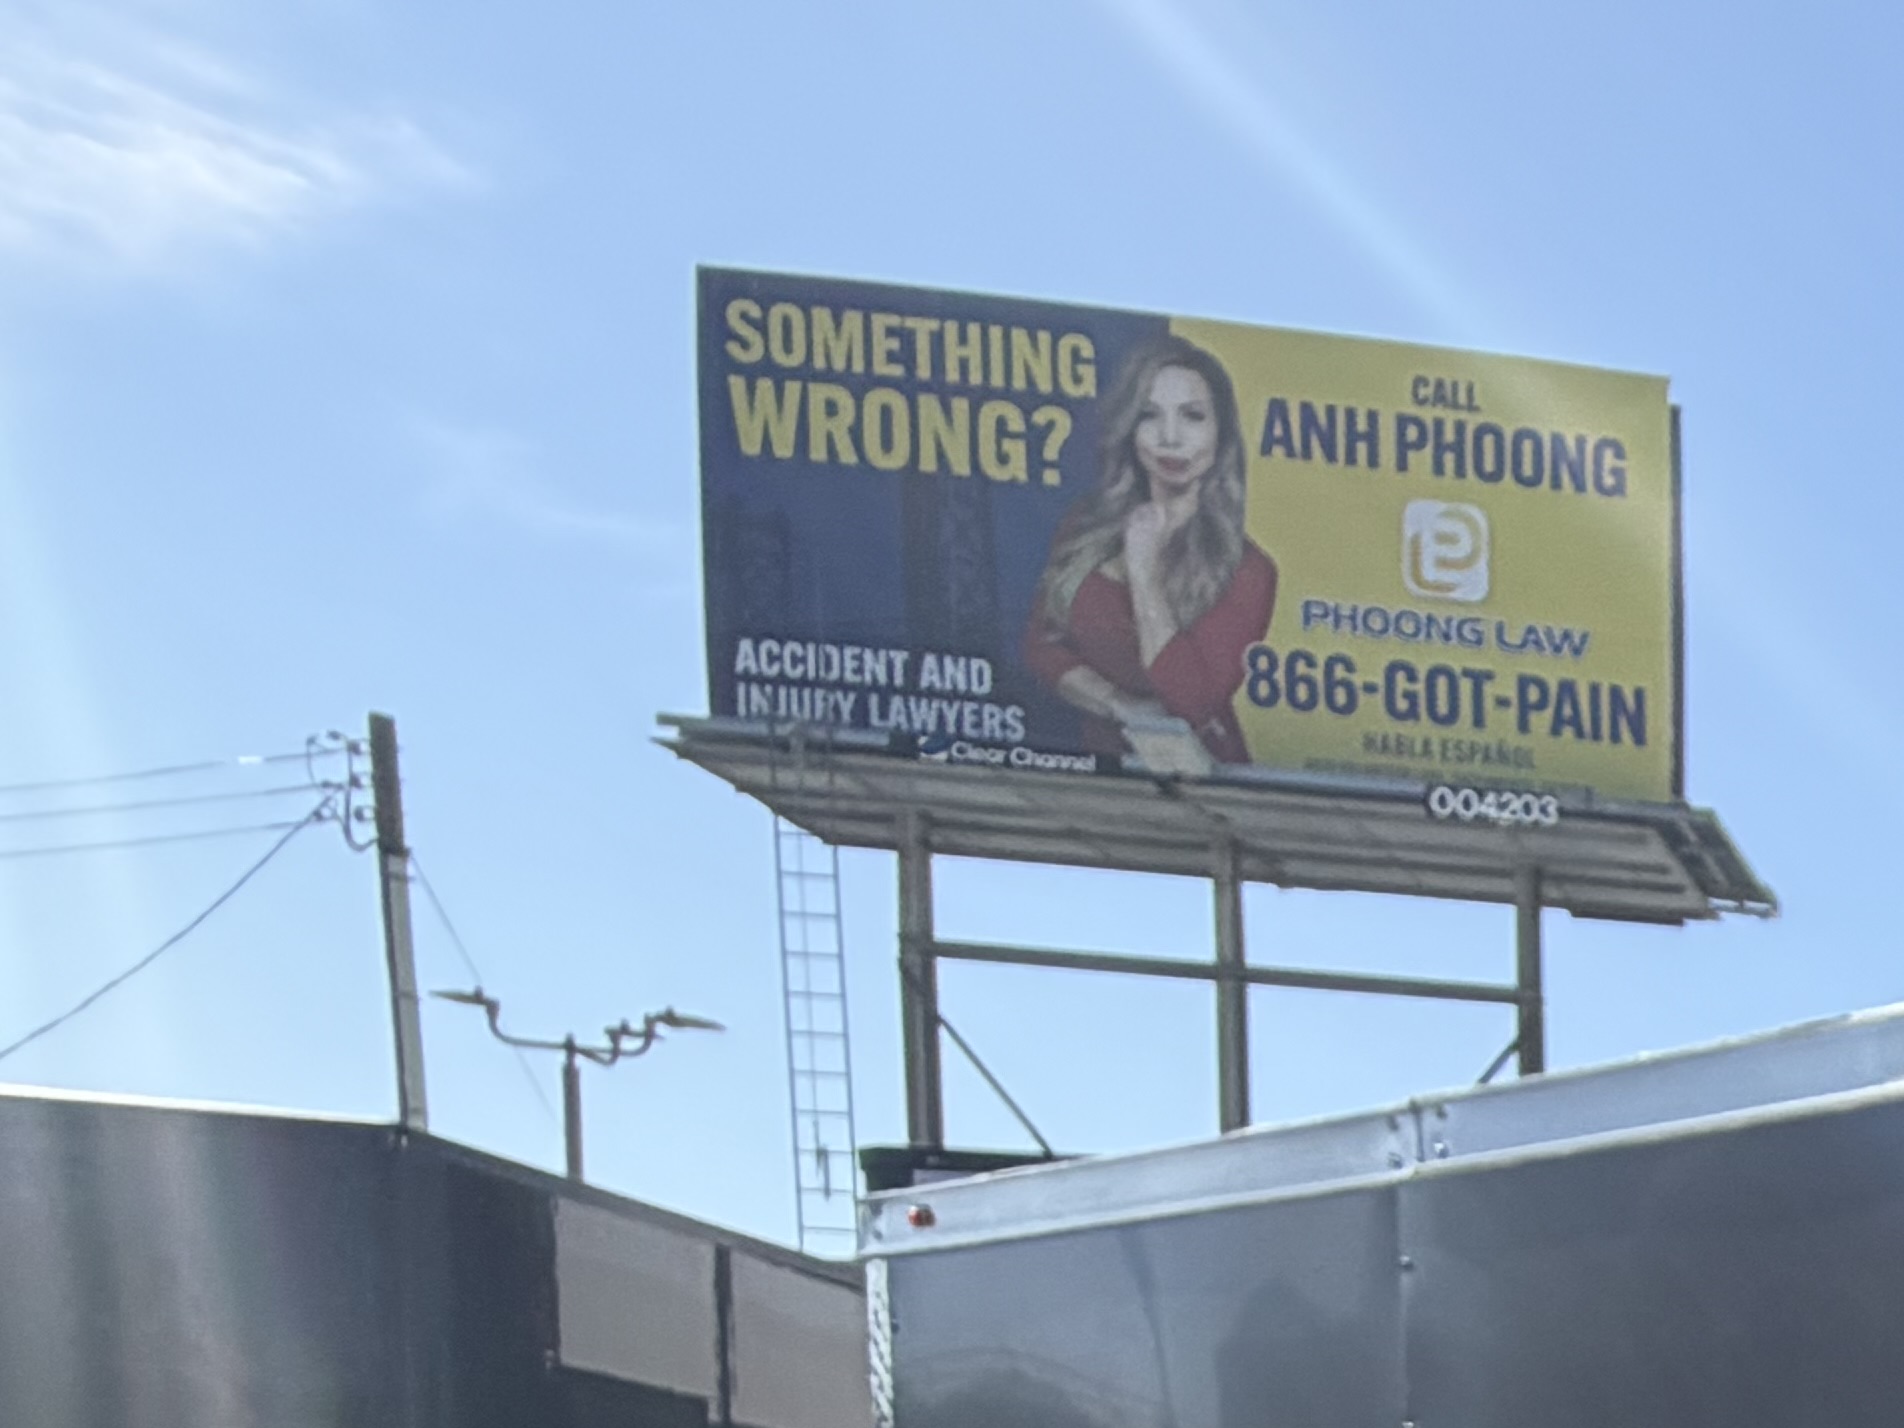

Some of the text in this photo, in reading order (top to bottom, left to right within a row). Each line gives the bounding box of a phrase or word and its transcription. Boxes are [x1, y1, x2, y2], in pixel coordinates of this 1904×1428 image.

[724, 298, 1097, 398] SOMETHING
[1411, 375, 1481, 412] CALL
[727, 373, 1073, 486] WRONG?
[1260, 397, 1628, 498] ANH PHOONG
[1302, 600, 1590, 658] PHOONG LAW
[734, 637, 993, 695] ACCIDENT AND
[1246, 643, 1648, 748] 866-GOT-PAIN
[736, 682, 1026, 743] INJURY LAWYERS
[950, 740, 1097, 772] Clear Channel
[1429, 785, 1559, 825] 004203
